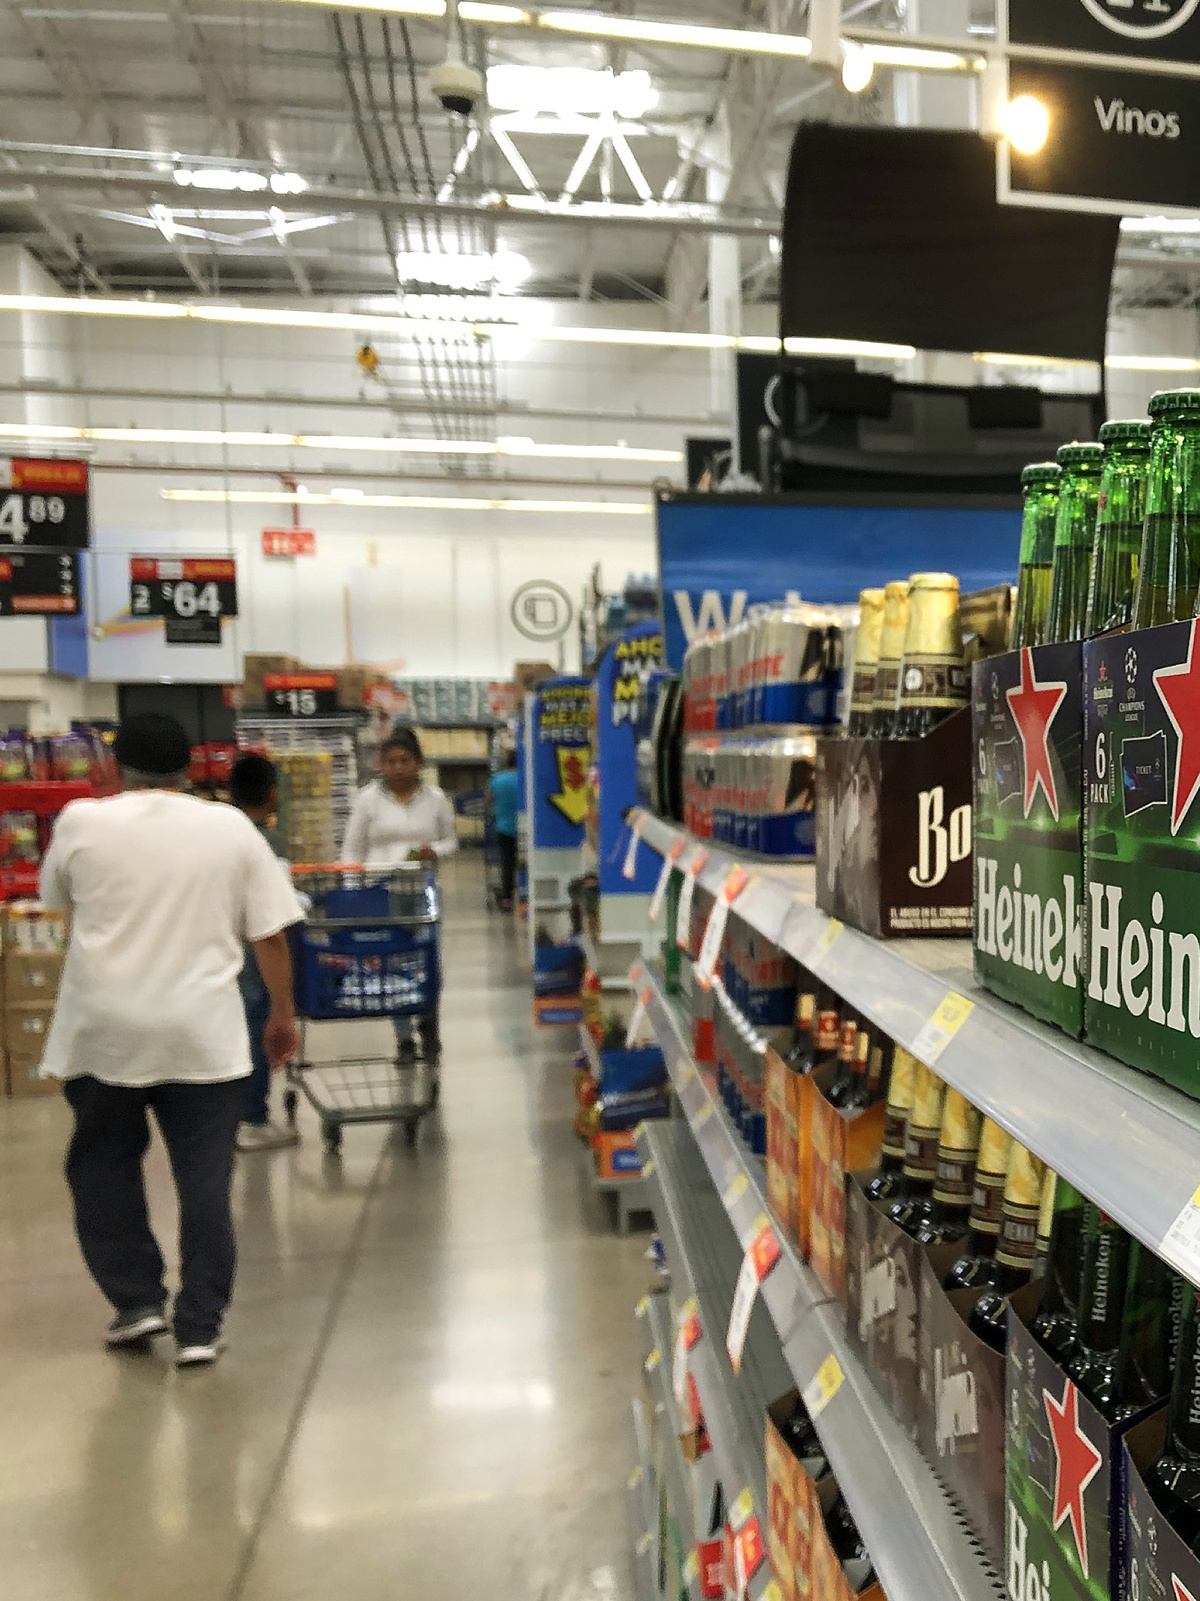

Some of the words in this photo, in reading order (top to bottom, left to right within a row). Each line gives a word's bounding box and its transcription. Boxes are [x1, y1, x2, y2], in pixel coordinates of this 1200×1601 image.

[1093, 95, 1181, 140] Vinos
[1095, 732, 1107, 780] 6
[1090, 784, 1110, 805] PACK
[1091, 1234, 1111, 1322] Heineken
